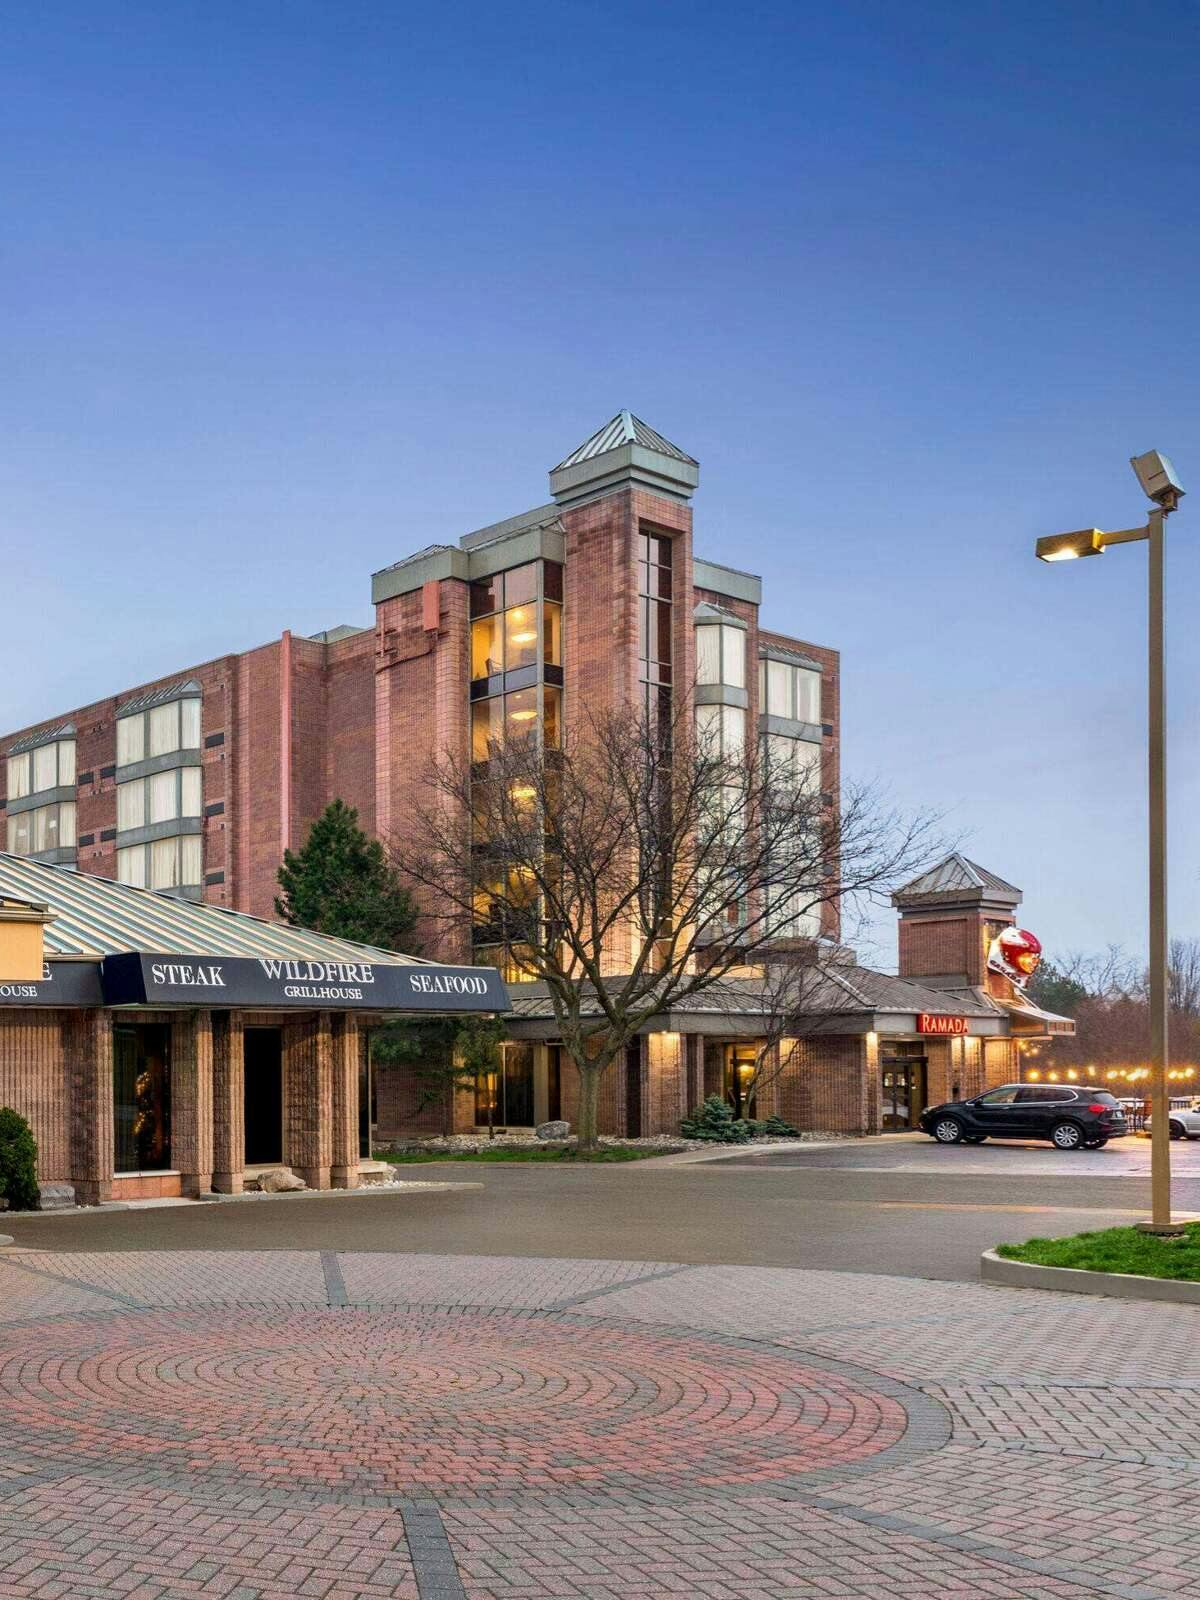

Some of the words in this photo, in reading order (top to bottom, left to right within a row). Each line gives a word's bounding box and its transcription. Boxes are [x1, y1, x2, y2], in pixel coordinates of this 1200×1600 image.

[151, 963, 226, 987] STEAK
[258, 959, 375, 983] WILDFIRE
[284, 985, 363, 1000] GRILLHOUSE
[409, 974, 488, 994] SEAFOOD
[922, 1014, 968, 1033] RAMADA
